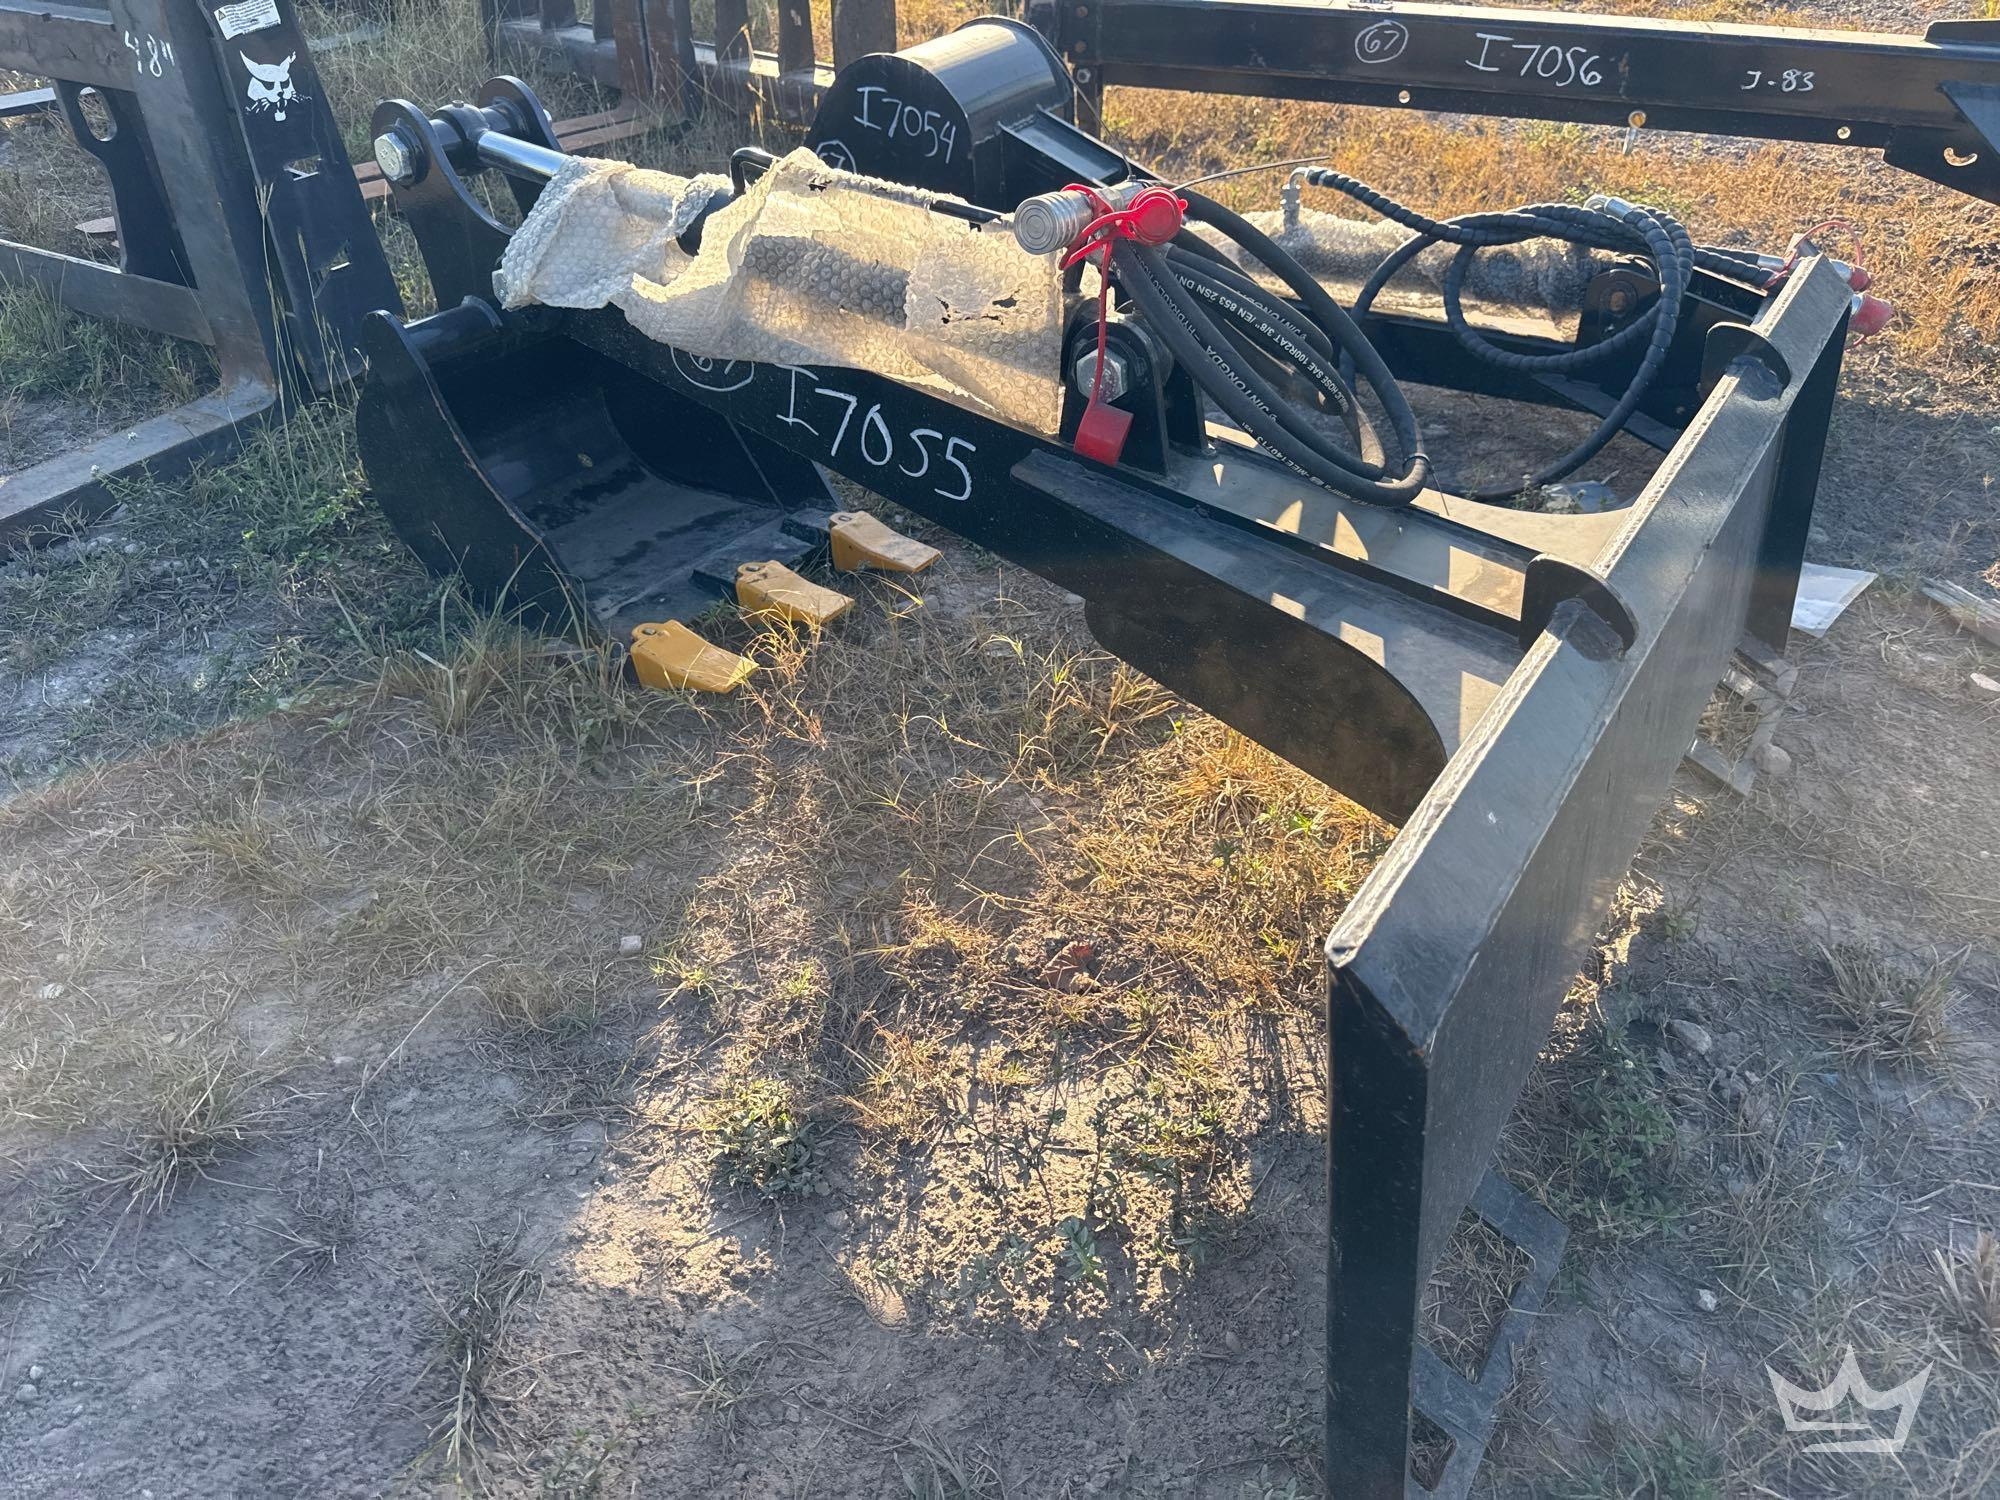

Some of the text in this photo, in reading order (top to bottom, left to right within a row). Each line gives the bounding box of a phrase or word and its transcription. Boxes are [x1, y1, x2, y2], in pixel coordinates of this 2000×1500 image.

[1465, 32, 1602, 87] I7056
[853, 86, 957, 164] I7054
[1196, 284, 1219, 301] 2SN
[1218, 296, 1238, 312] 853
[1237, 307, 1257, 324] /EN
[1254, 323, 1276, 337] 3/8"
[1273, 334, 1309, 365] 100R2AT
[1307, 362, 1324, 379] SAE
[1320, 375, 1338, 395] HOSE
[774, 363, 977, 501] I7055
